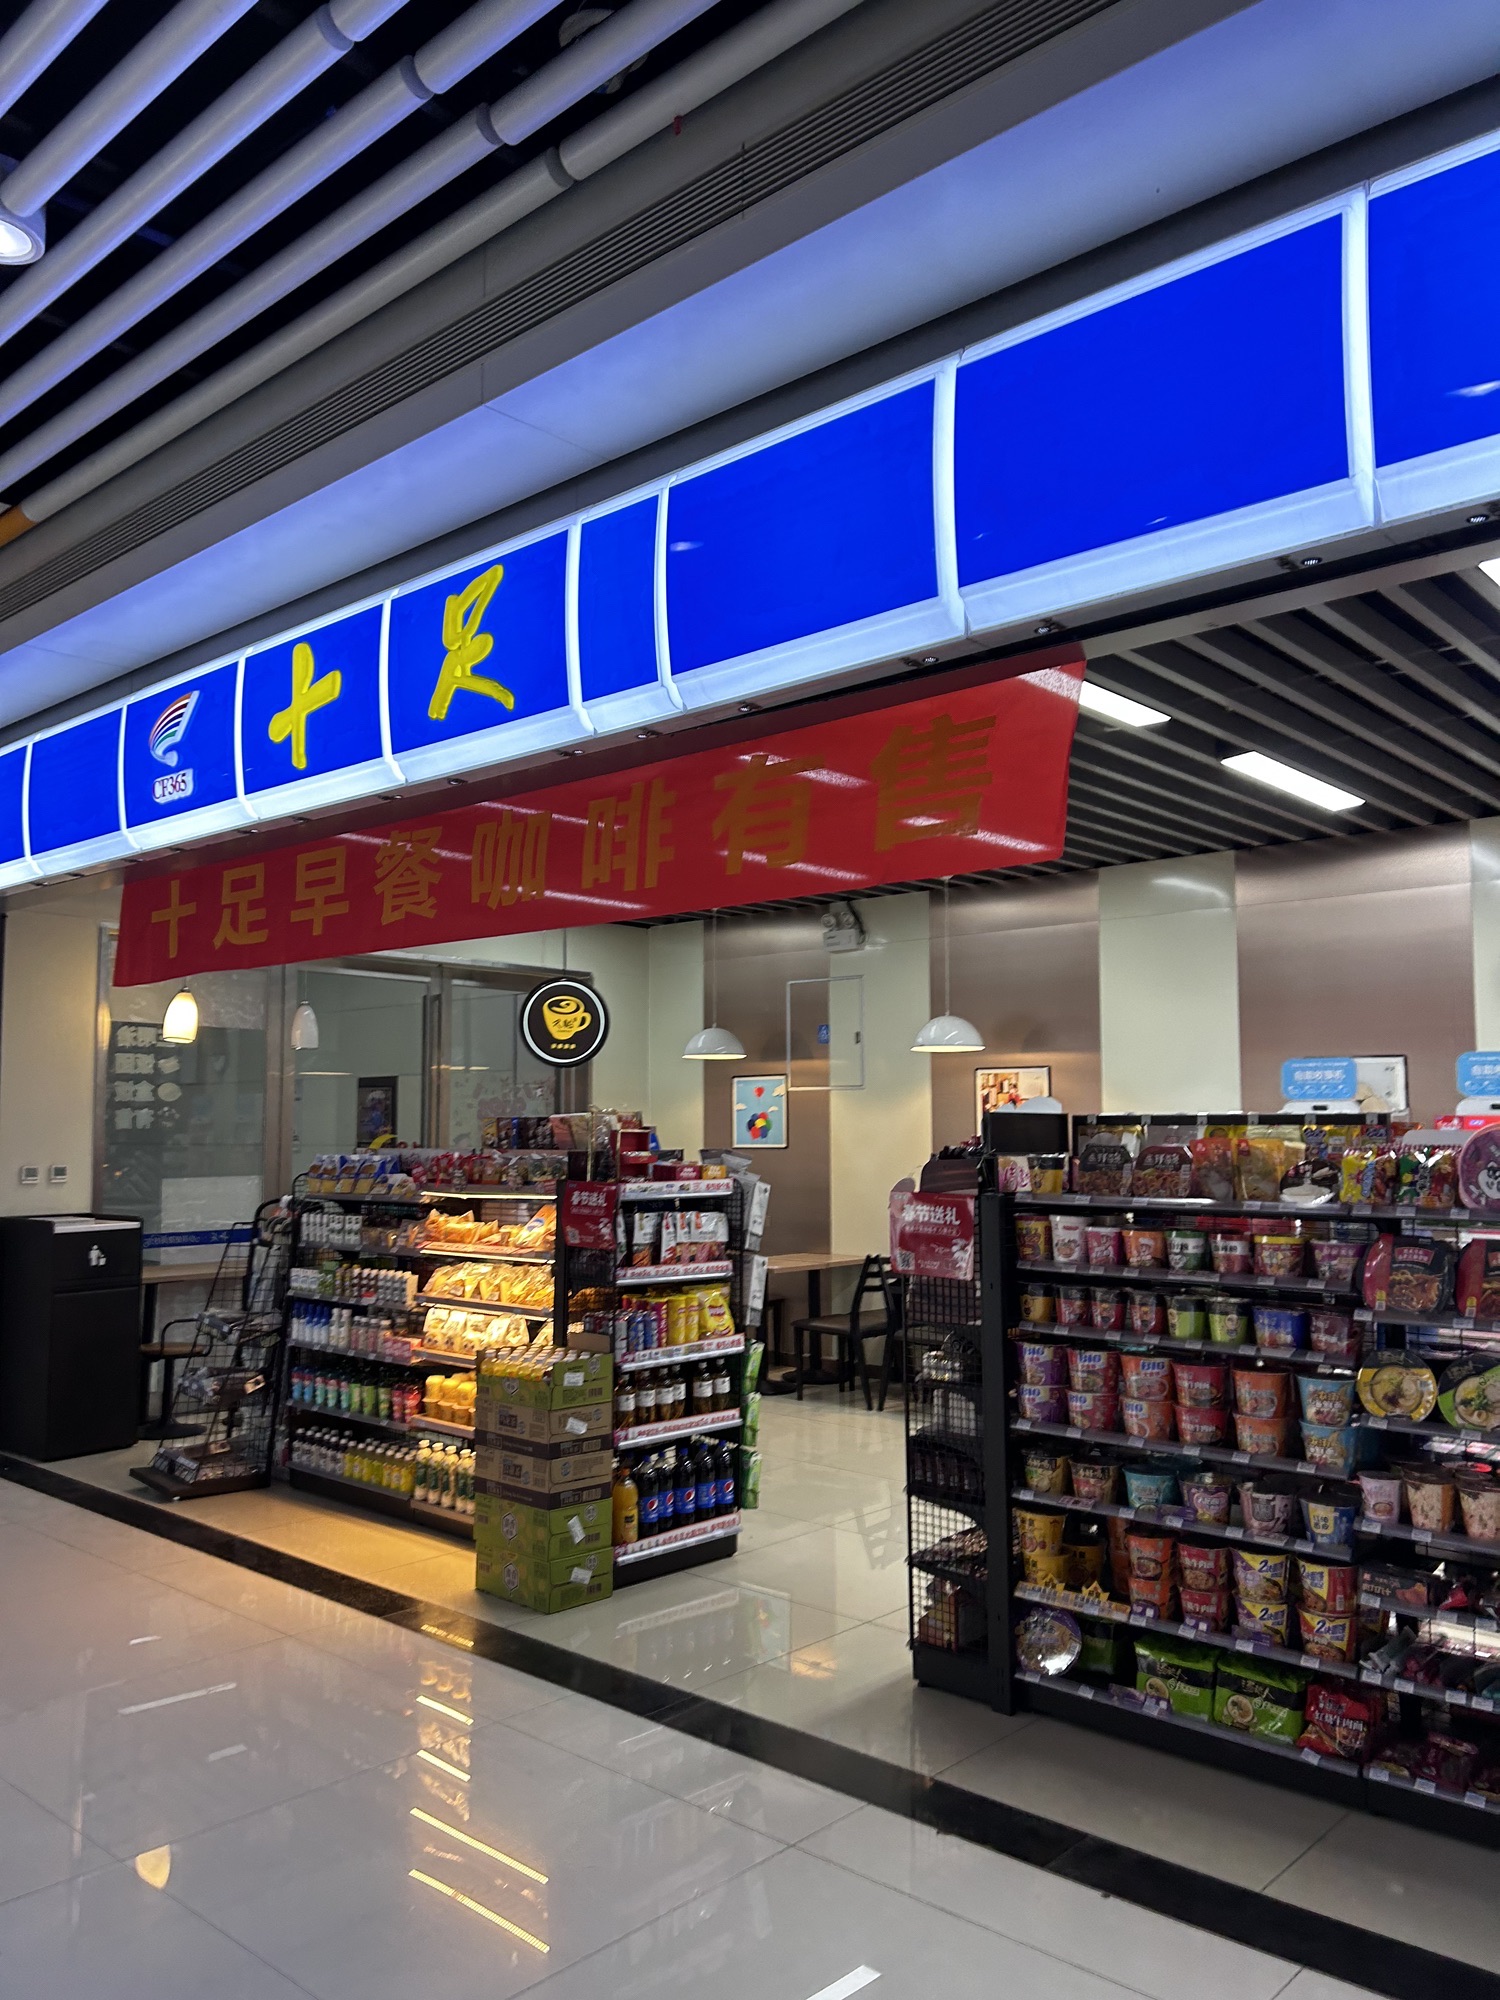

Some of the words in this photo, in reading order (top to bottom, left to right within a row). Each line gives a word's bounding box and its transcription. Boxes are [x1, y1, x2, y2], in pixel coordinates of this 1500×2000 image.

[268, 564, 515, 769] 十足
[153, 772, 187, 800] CF365
[151, 713, 996, 959] 十足早餐咖啡有售
[902, 1204, 961, 1225] 春节送礼
[1079, 1353, 1102, 1364] BIG
[1141, 1360, 1165, 1371] BIG
